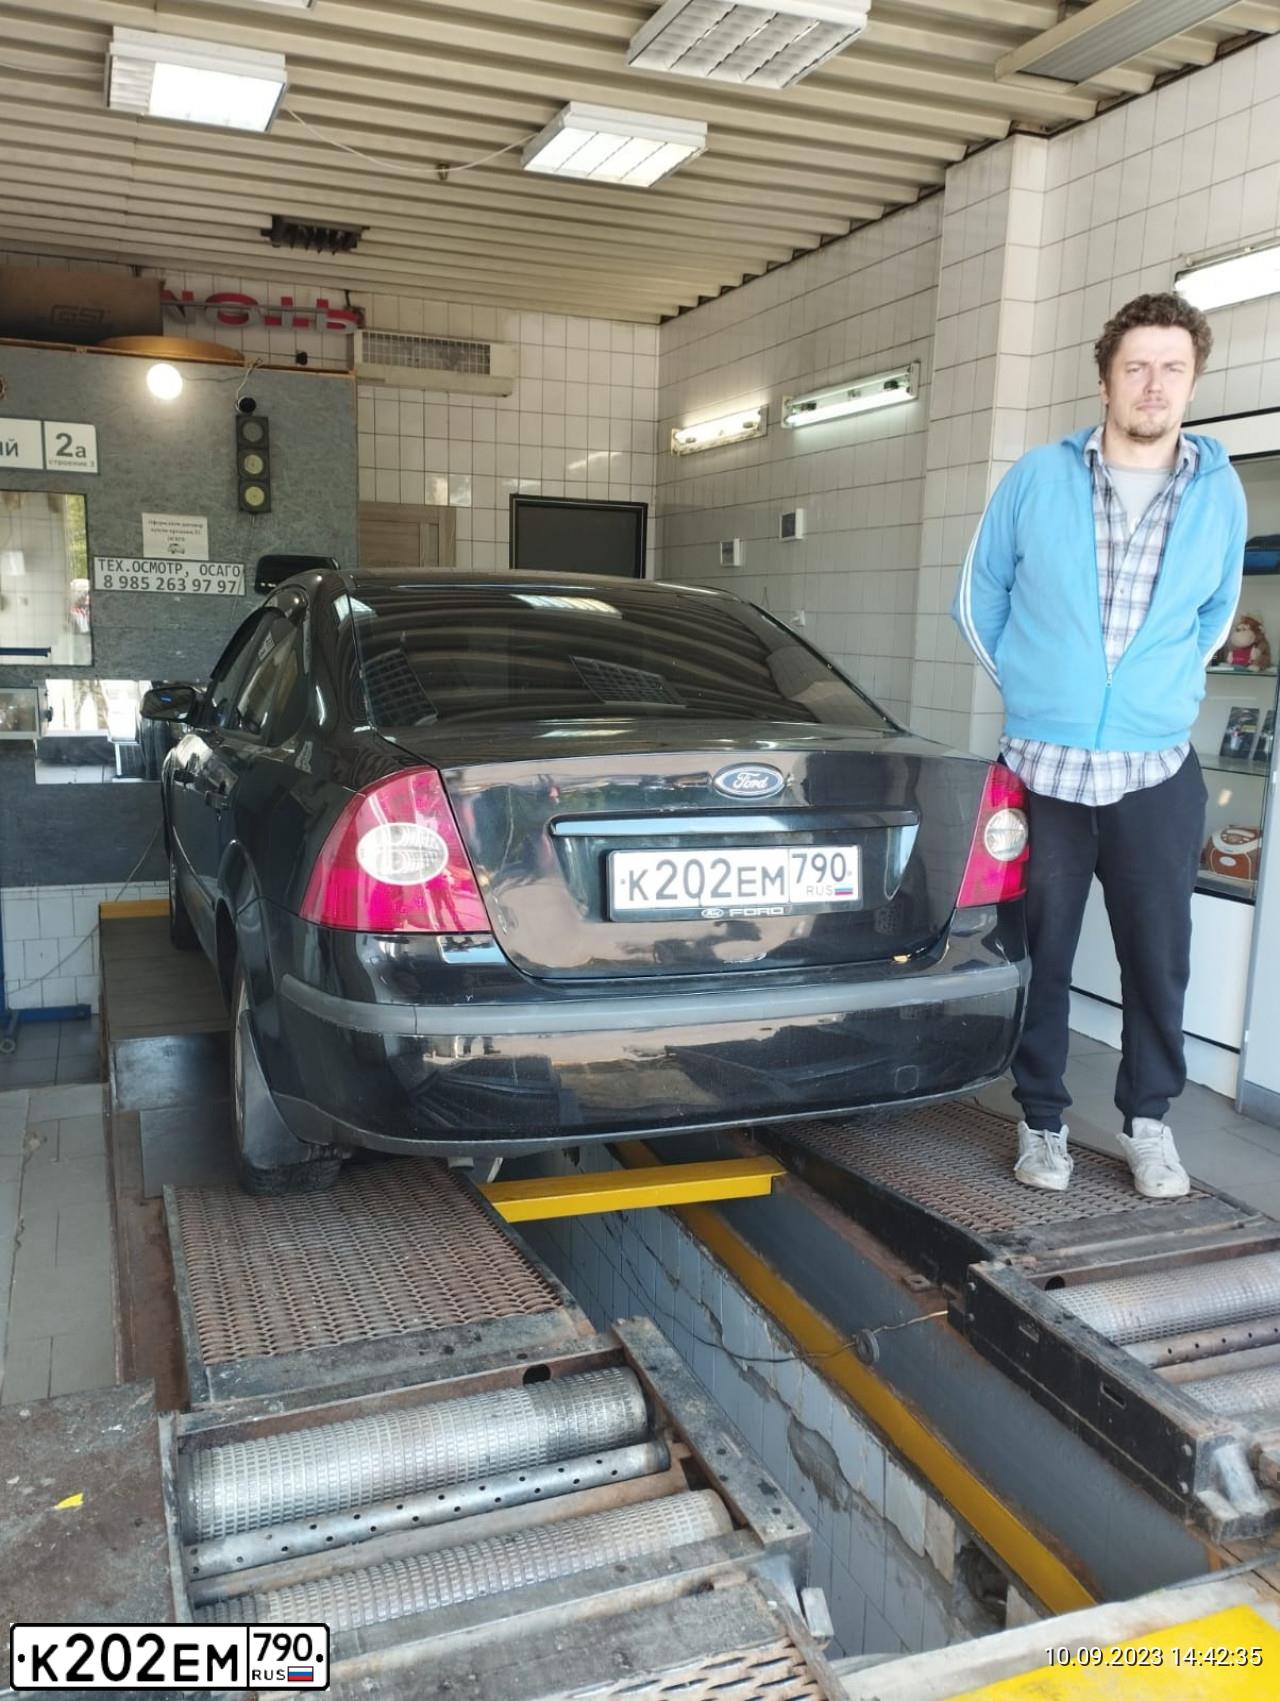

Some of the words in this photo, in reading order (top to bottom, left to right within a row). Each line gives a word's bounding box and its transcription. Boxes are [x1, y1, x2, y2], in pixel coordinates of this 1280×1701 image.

[199, 564, 241, 577] ОСАГО
[103, 575, 113, 589] 8
[118, 575, 150, 590] 985
[155, 577, 187, 591] 263
[191, 578, 212, 593] 97
[217, 580, 237, 593] 97
[732, 772, 769, 790] Ford
[791, 852, 847, 884] 790
[806, 885, 834, 896] RUS
[729, 907, 785, 917] FORD
